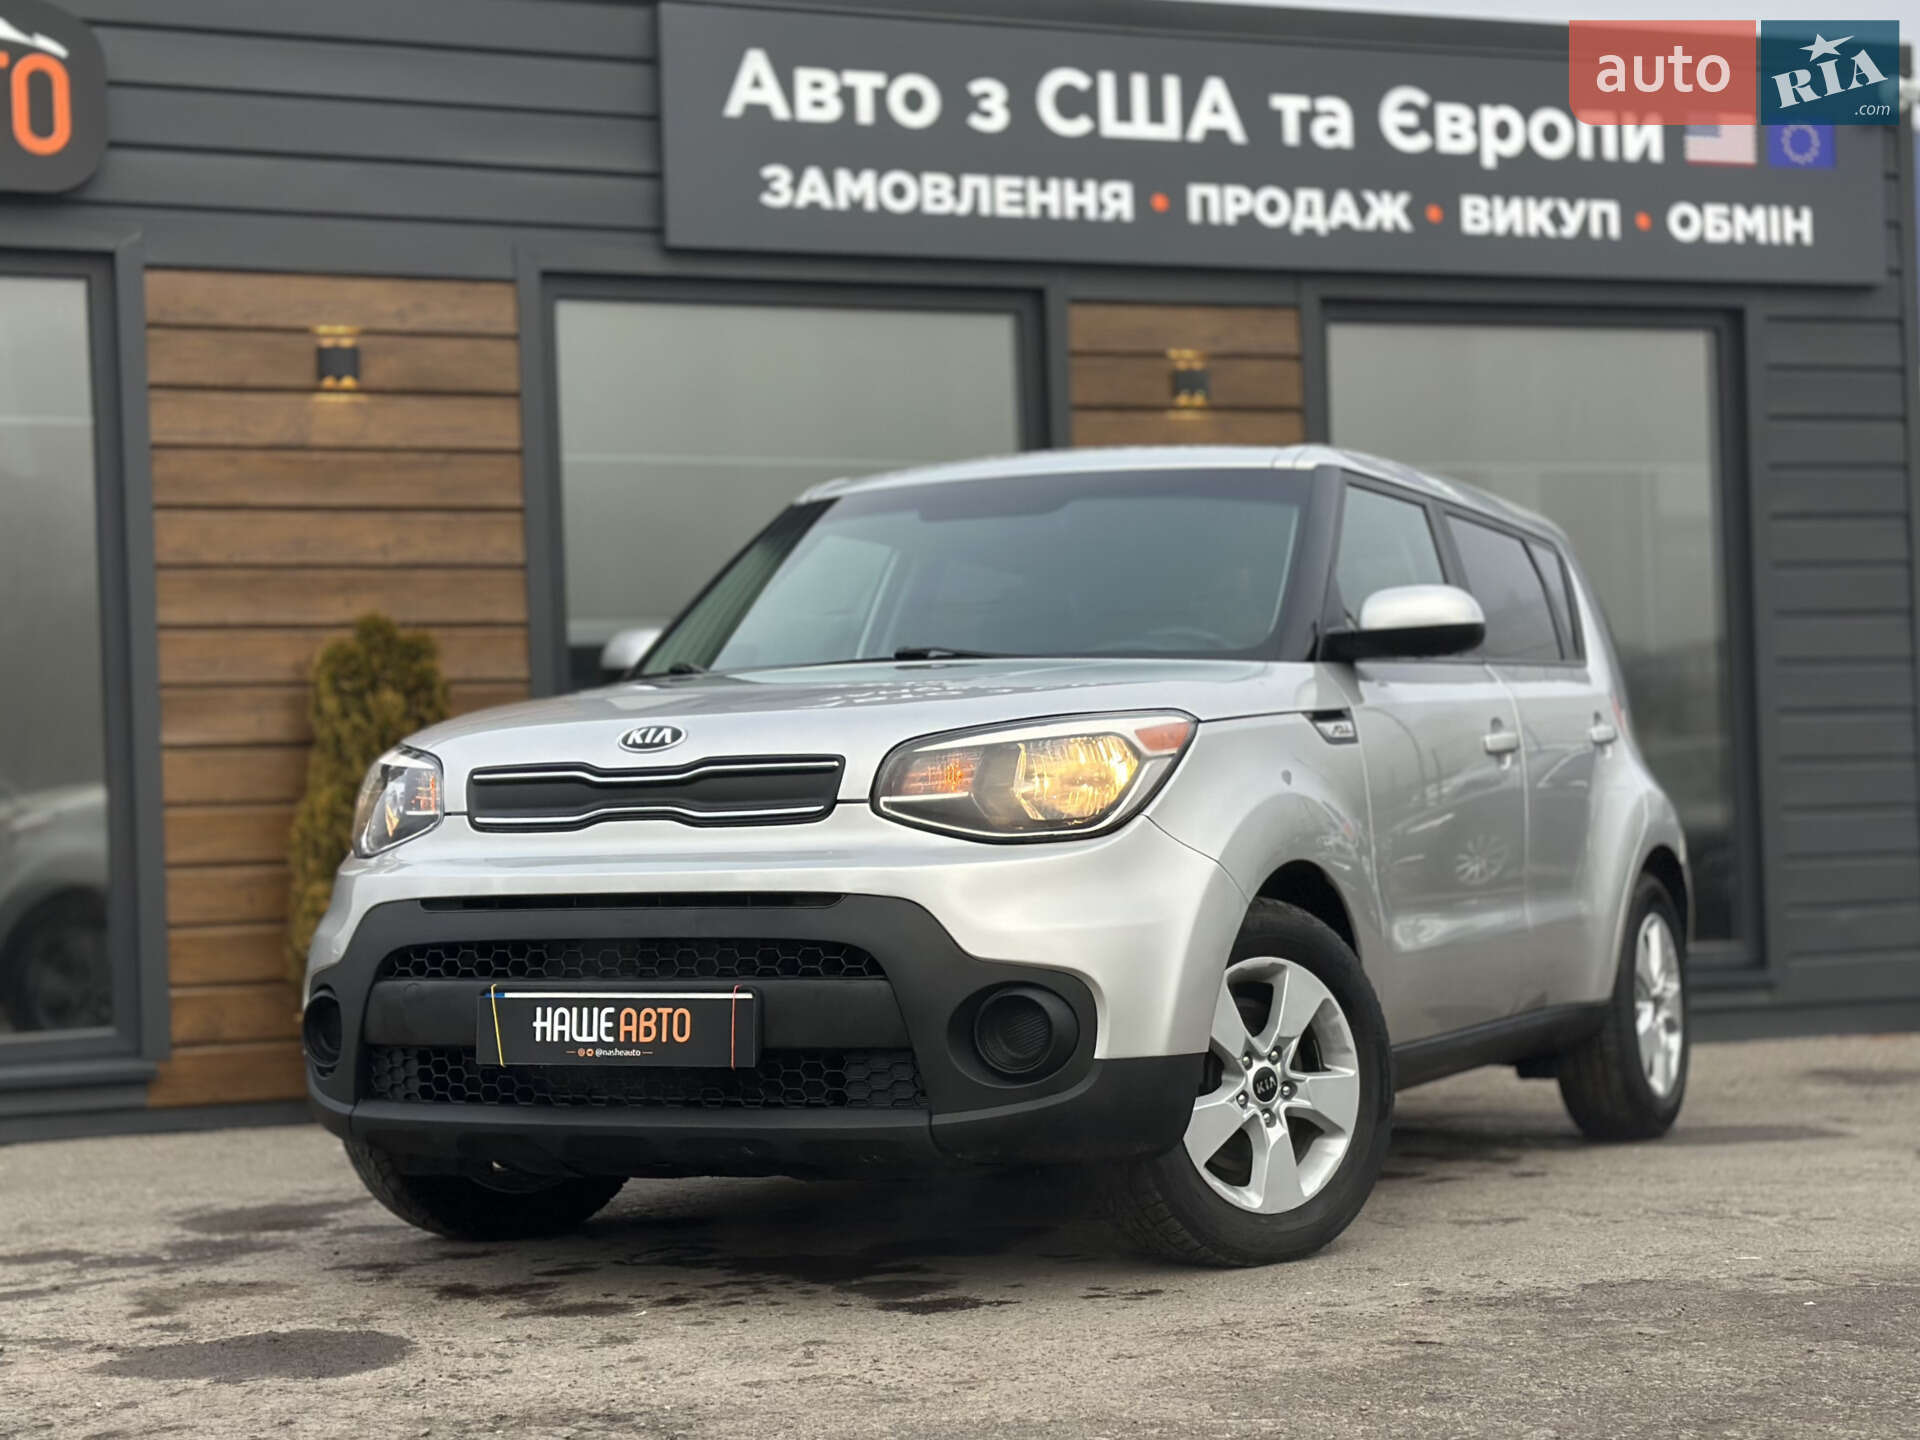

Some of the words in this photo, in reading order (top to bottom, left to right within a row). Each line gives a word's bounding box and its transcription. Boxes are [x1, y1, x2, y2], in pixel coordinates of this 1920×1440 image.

[723, 47, 943, 130] Авто
[966, 77, 1011, 134] з
[1035, 66, 1248, 145] США
[1269, 93, 1355, 149] та
[1379, 85, 1665, 169] Європи
[760, 163, 1136, 222] ЗАМОВЛЕННЯ
[1186, 183, 1413, 236] ПРОДАЖ
[1460, 194, 1621, 240] ВИКУП
[1666, 201, 1814, 246] ОБМІН
[626, 727, 673, 745] KIA
[532, 1006, 616, 1043] НАШЕ
[619, 1007, 692, 1043] АВТО
[595, 1047, 641, 1058] @nasheauto
[1256, 1076, 1277, 1094] KIA
